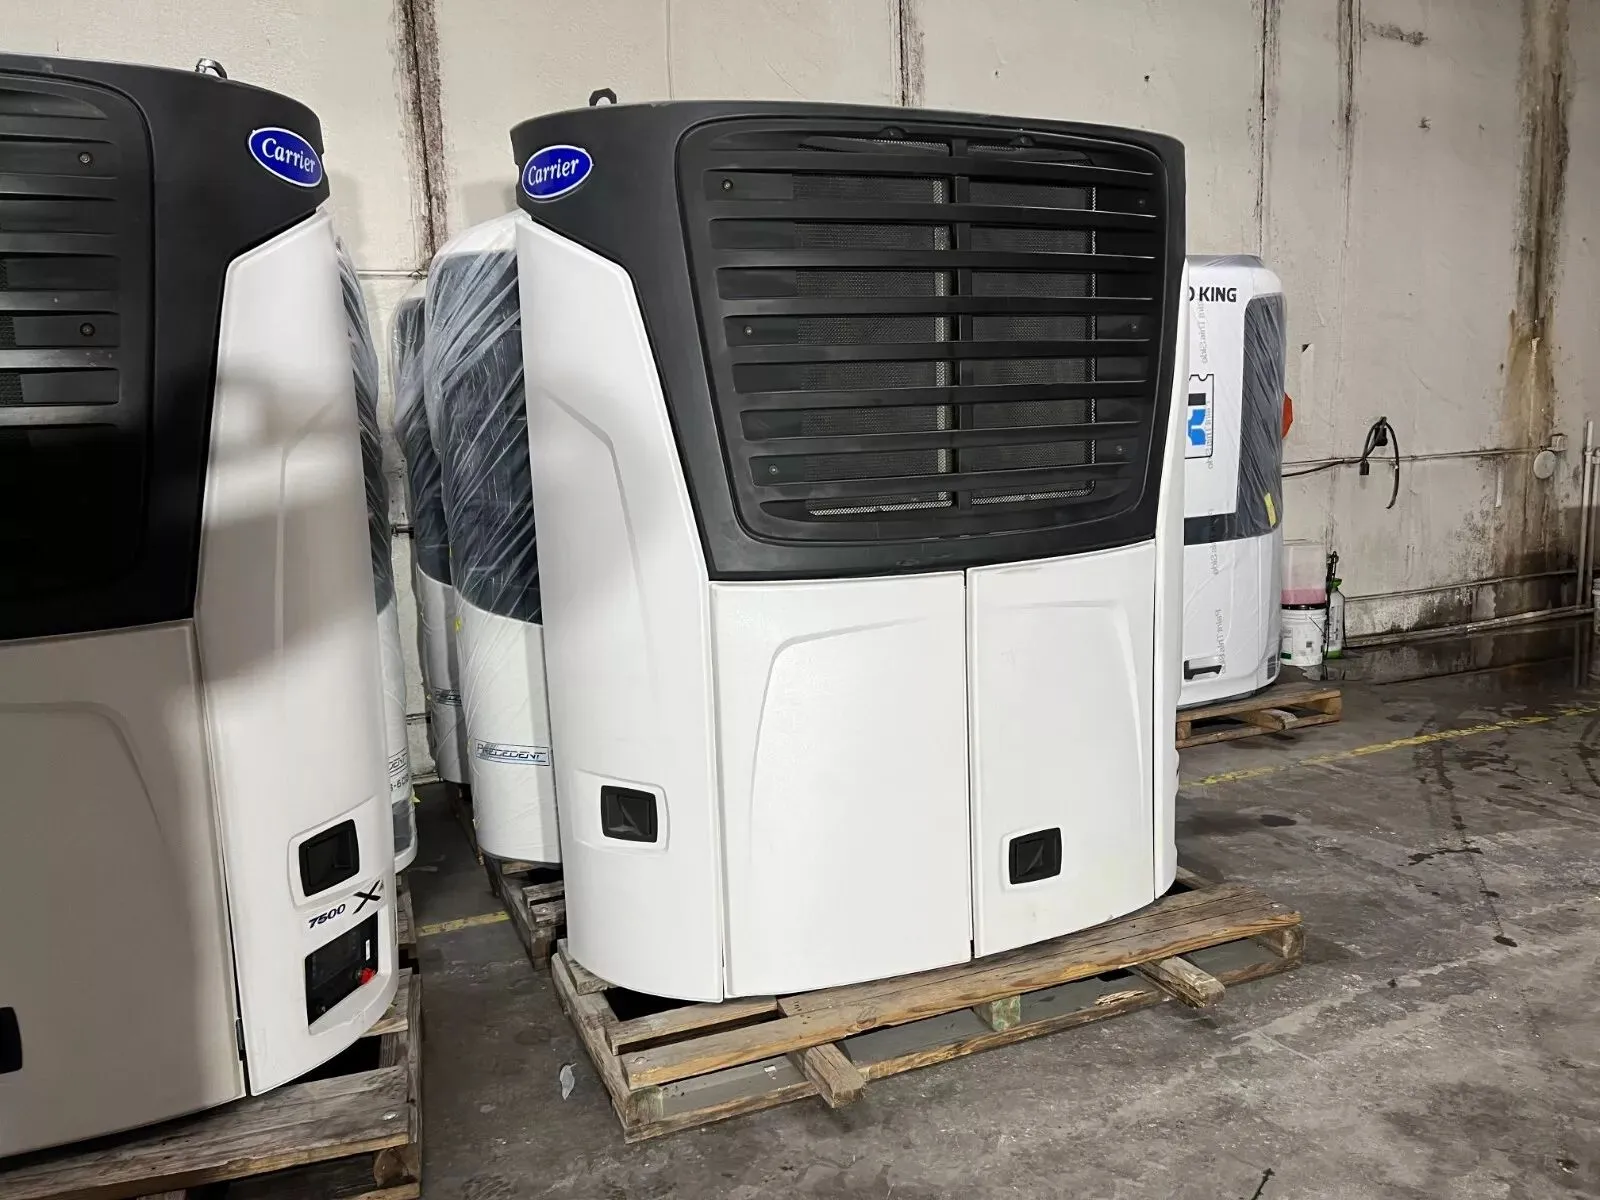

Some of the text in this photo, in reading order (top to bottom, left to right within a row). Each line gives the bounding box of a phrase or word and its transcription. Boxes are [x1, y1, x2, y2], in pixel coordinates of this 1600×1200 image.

[262, 137, 316, 173] Carrier
[528, 158, 580, 187] Carrier
[1199, 286, 1238, 303] KING
[308, 903, 347, 929] 7500
